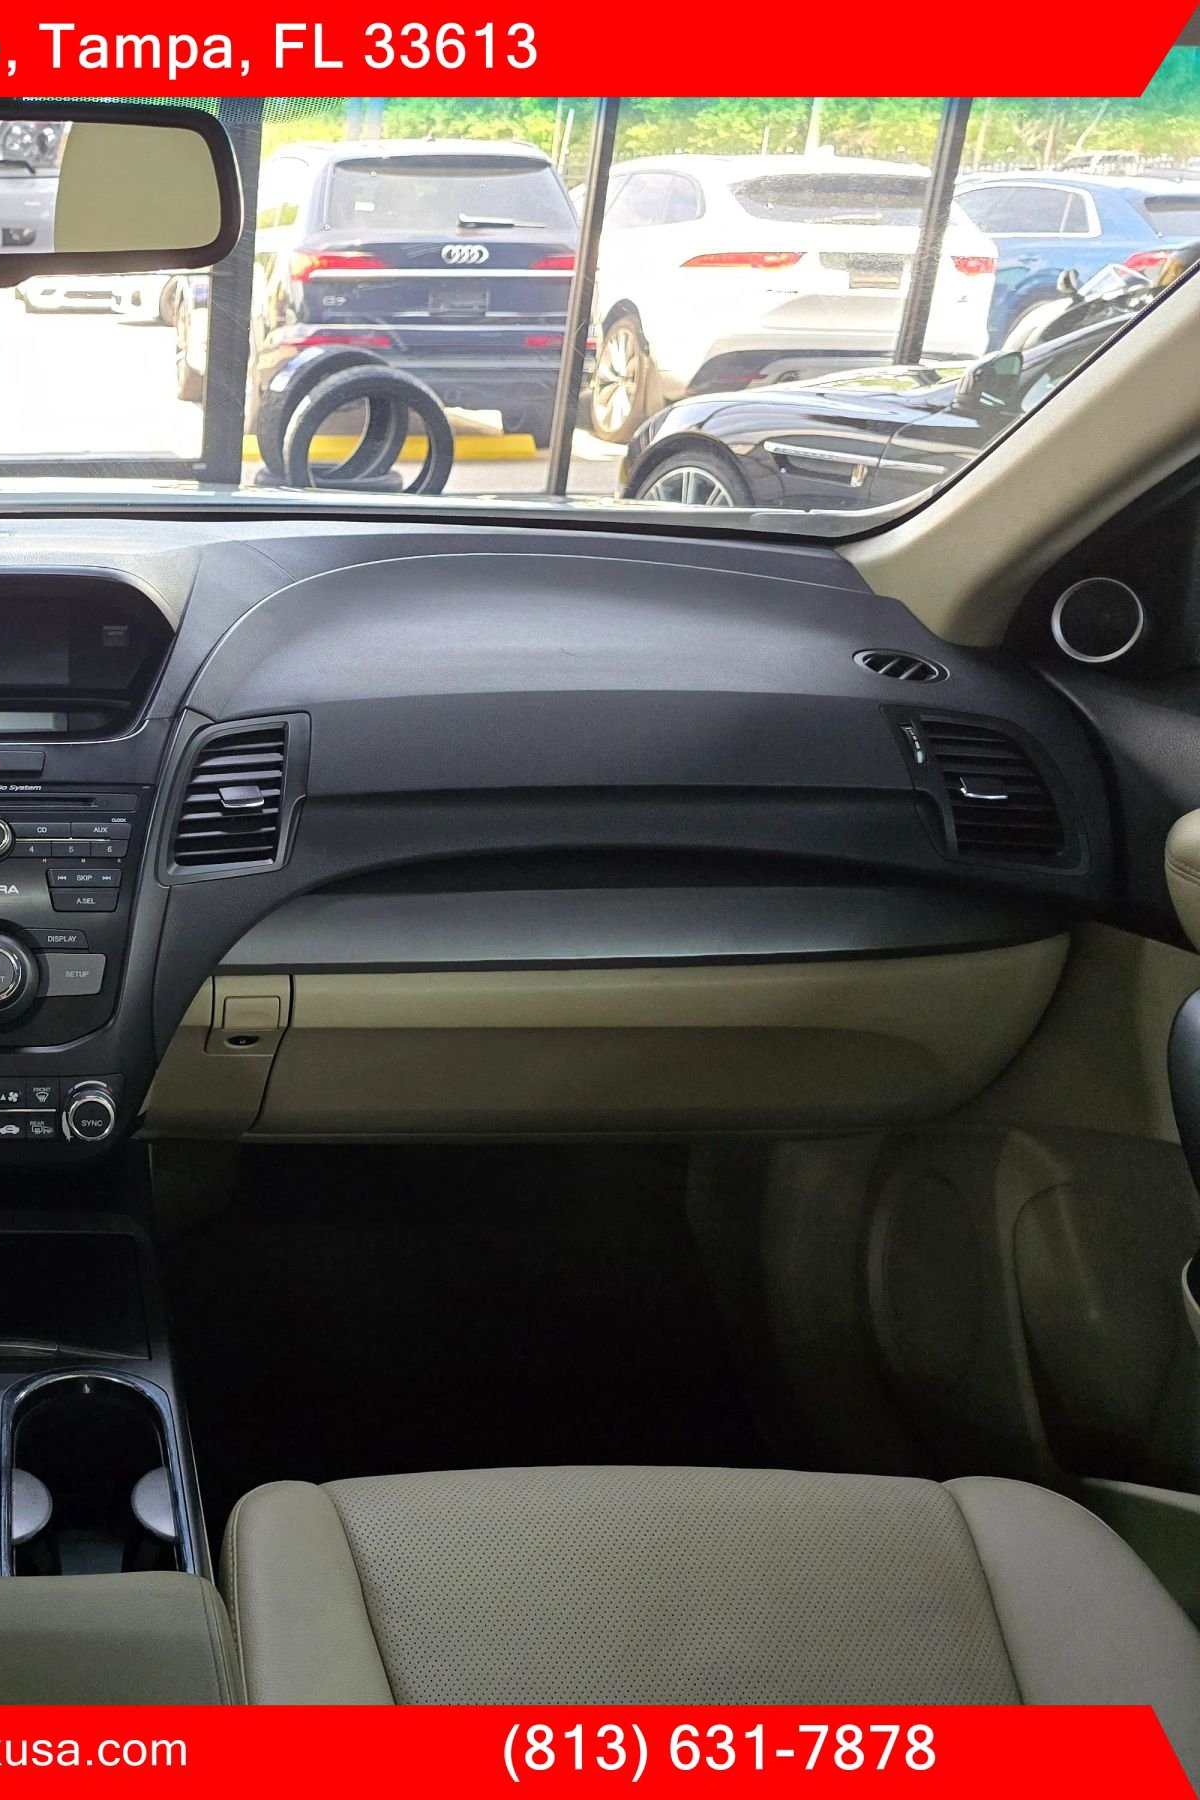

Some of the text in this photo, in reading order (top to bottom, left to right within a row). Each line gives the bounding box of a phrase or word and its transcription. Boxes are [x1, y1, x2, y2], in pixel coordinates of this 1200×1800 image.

[8, 784, 42, 792] System
[28, 845, 35, 853] 4
[68, 845, 74, 853] 5
[107, 845, 113, 853] 6
[47, 935, 77, 943] DISPLAY
[64, 970, 89, 978] SETUP
[80, 1119, 103, 1127] SYNC
